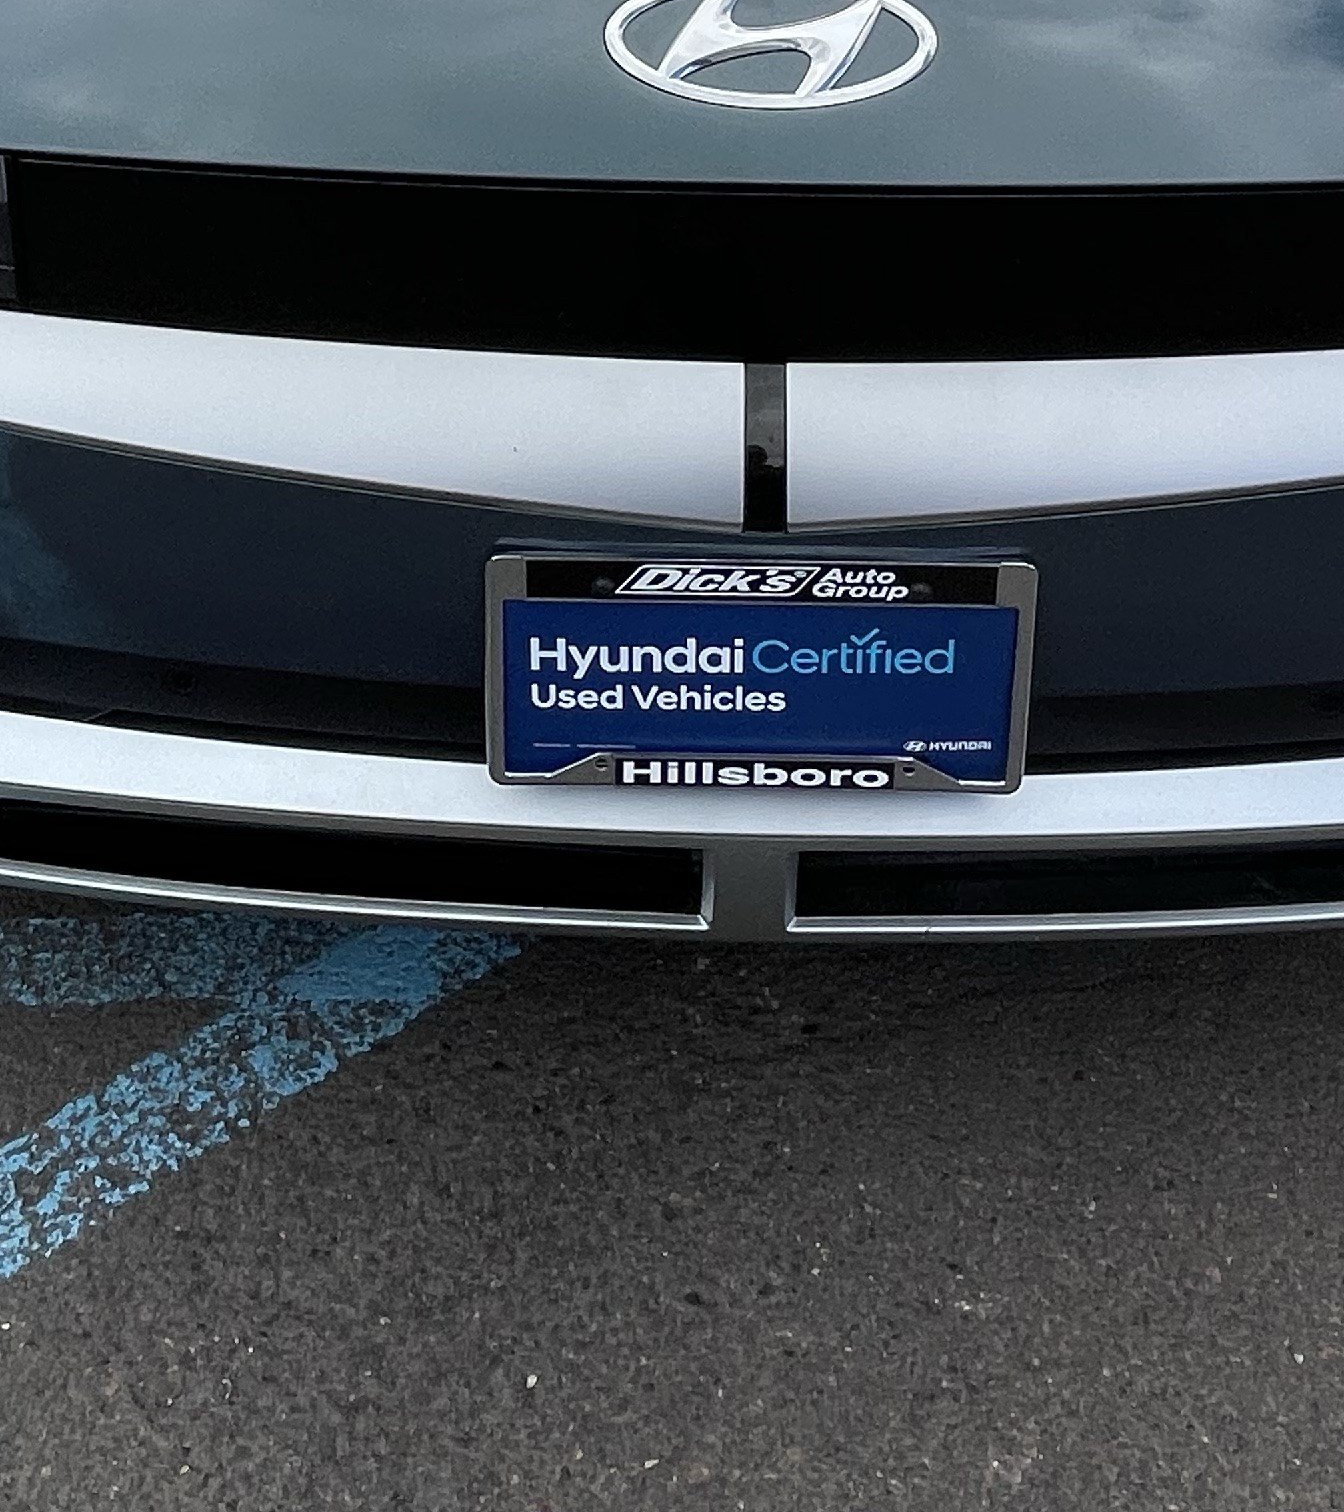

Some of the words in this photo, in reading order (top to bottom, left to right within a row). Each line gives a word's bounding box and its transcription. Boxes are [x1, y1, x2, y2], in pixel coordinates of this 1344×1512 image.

[819, 568, 897, 585] Auto
[812, 582, 910, 602] Group
[529, 636, 745, 680] Hyundai
[752, 628, 956, 675] Certified
[530, 684, 624, 710] Used
[631, 684, 787, 712] Vehicles
[622, 760, 890, 788] Hillsboro
